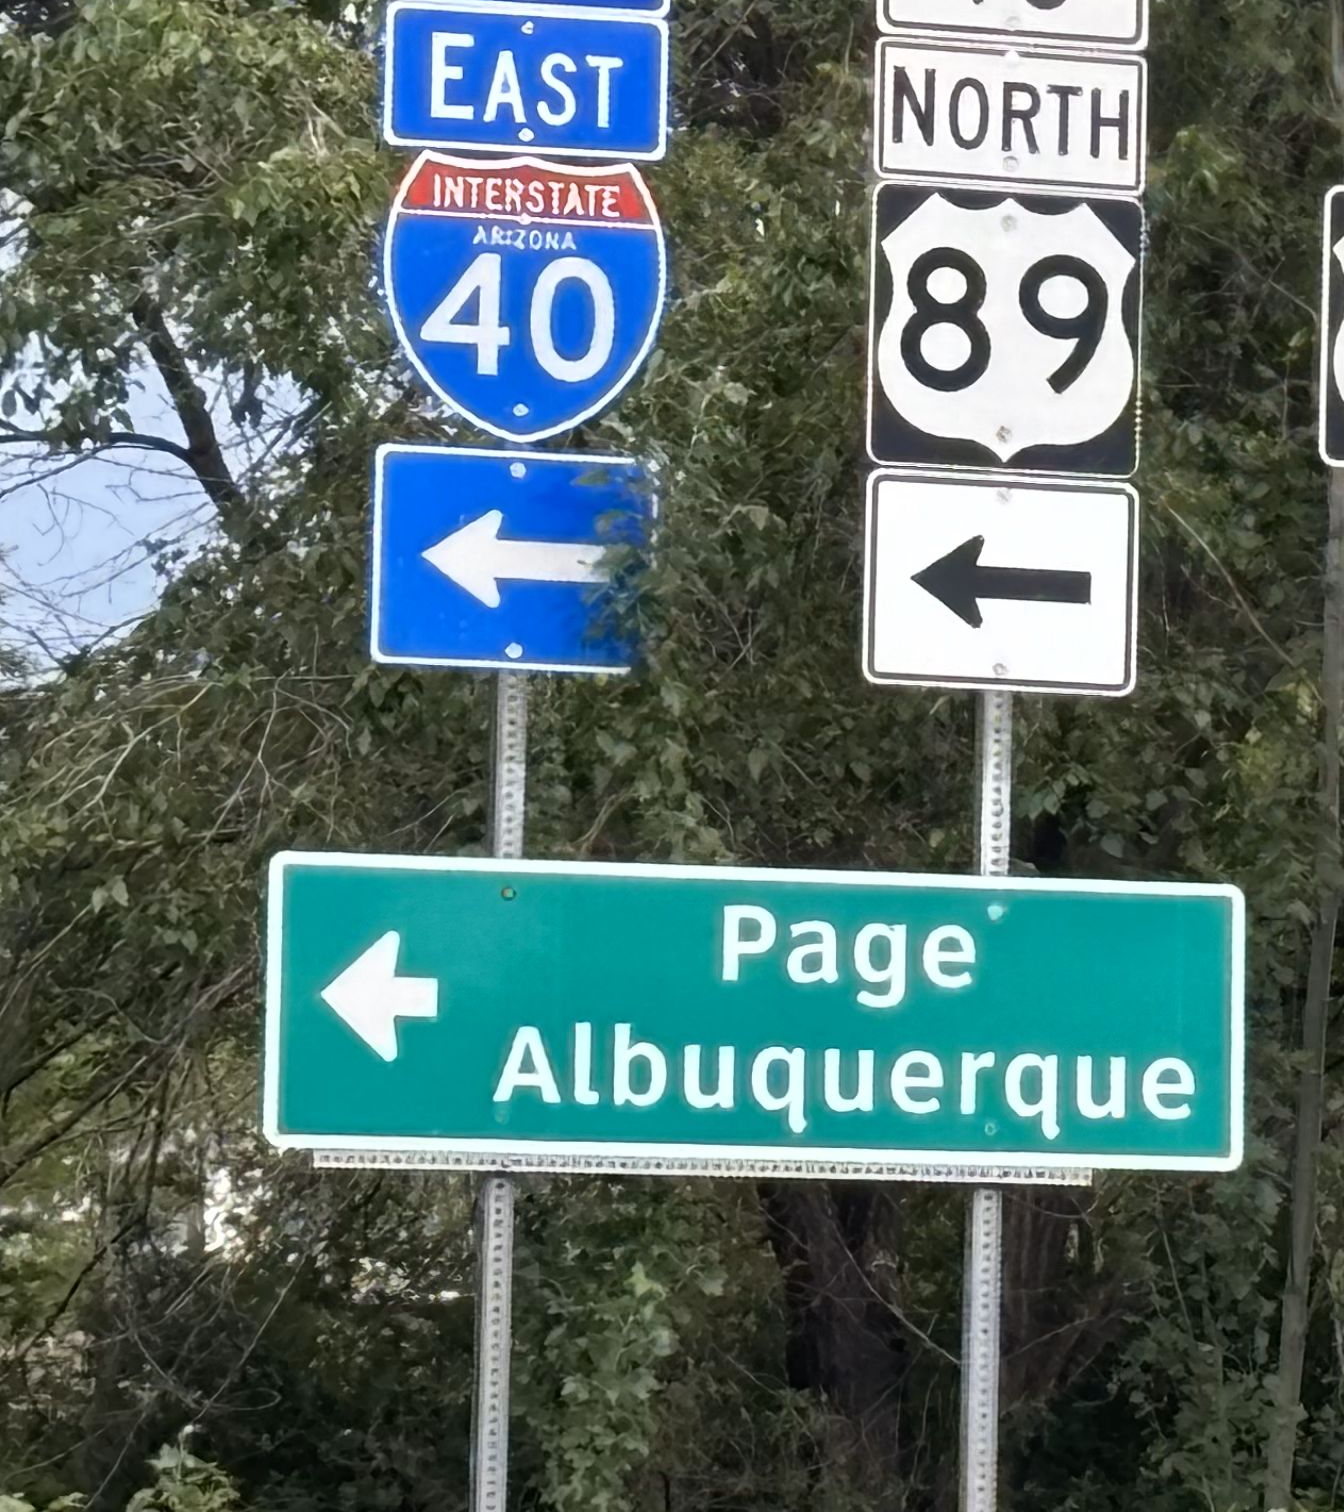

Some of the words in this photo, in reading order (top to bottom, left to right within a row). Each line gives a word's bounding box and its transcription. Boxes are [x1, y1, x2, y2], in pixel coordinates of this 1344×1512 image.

[430, 30, 624, 129] EAST
[892, 64, 1130, 161] NORTH
[432, 175, 622, 218] INTERSTATE
[472, 226, 576, 252] ARIZONA
[419, 252, 616, 383] 40
[900, 246, 1109, 394] 89
[722, 904, 977, 1009] Page
[492, 1021, 1196, 1140] Albuquerque
